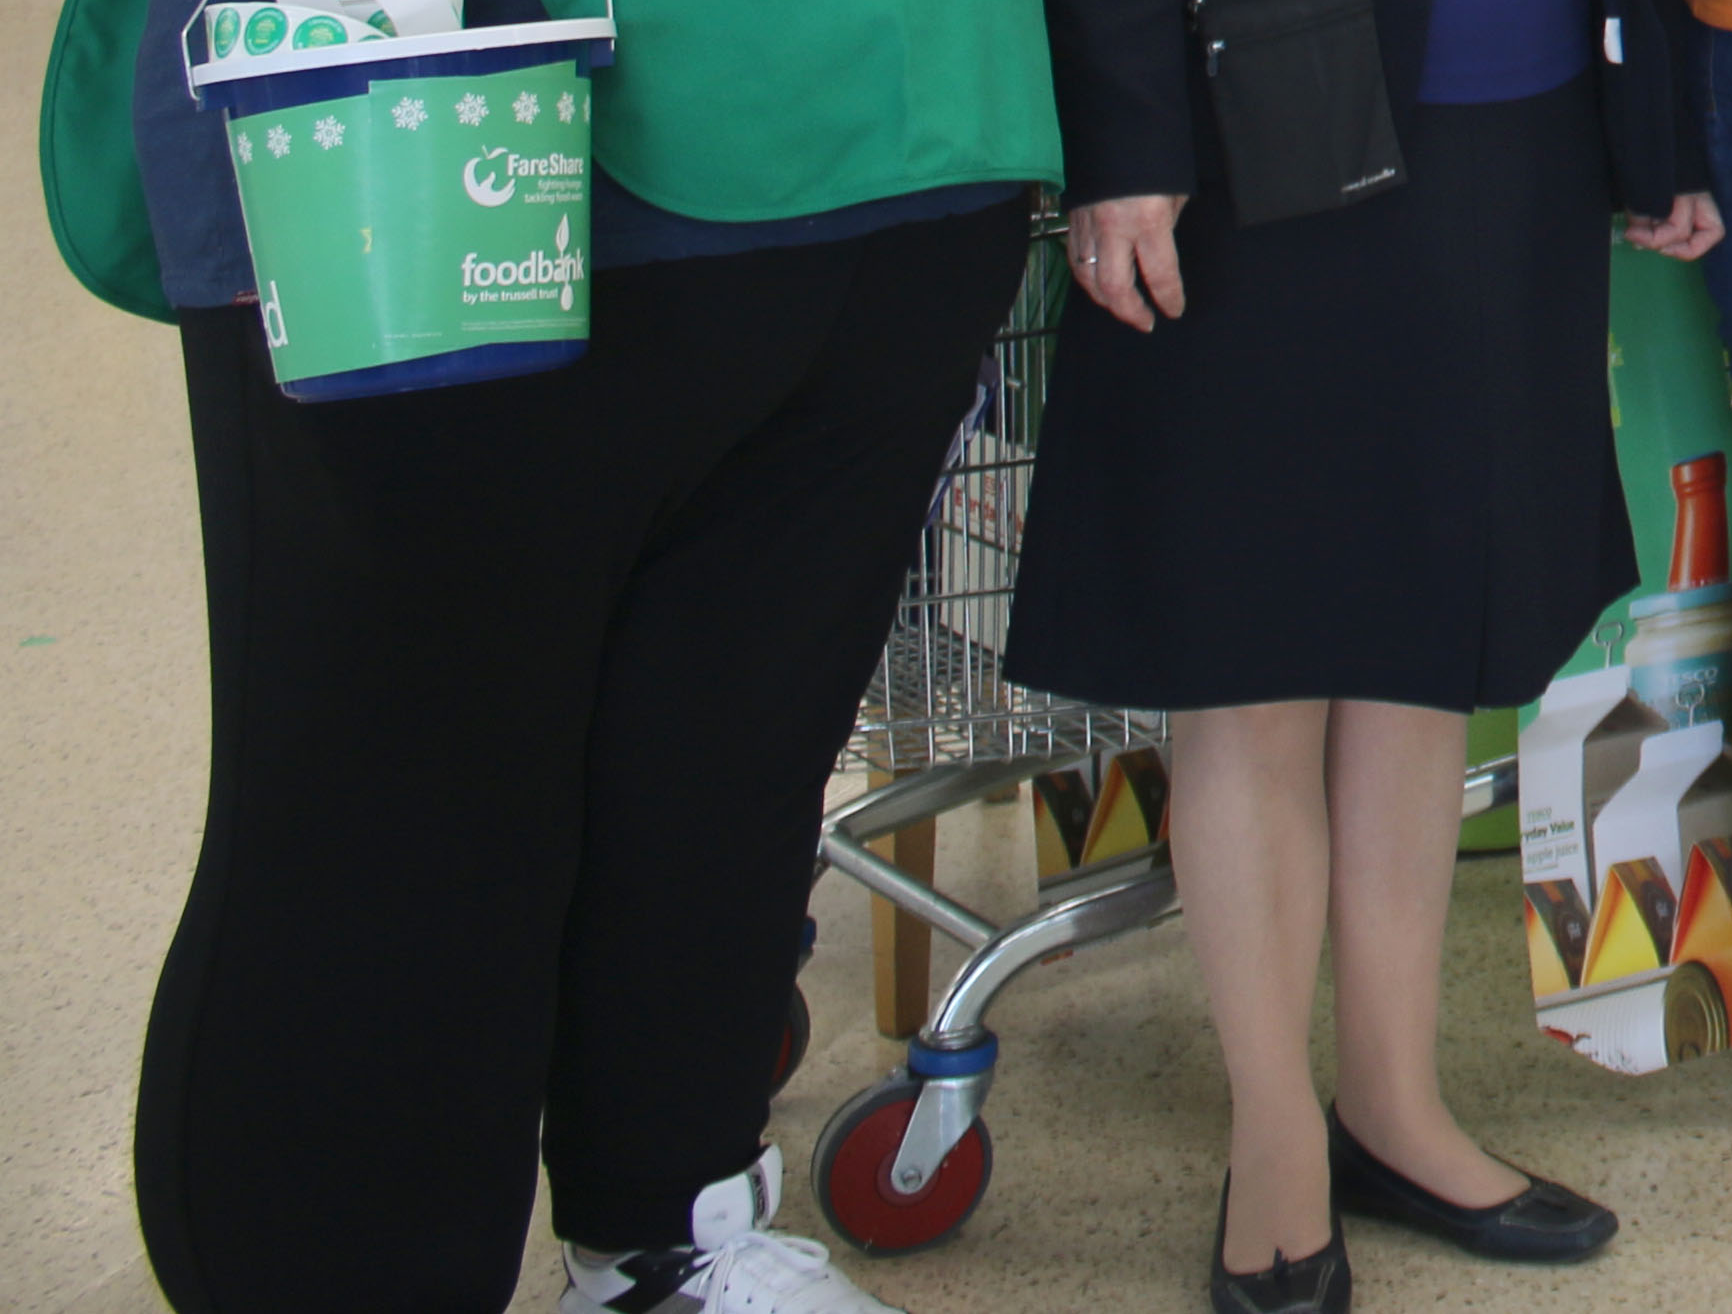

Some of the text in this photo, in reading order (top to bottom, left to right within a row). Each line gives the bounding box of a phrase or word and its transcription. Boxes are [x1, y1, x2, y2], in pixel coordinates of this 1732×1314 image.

[507, 153, 584, 177] FareShare
[461, 247, 584, 288] foodbank
[463, 288, 559, 305] by the trussell trust
[1550, 820, 1575, 835] Value
[1526, 843, 1579, 865] apple juice
